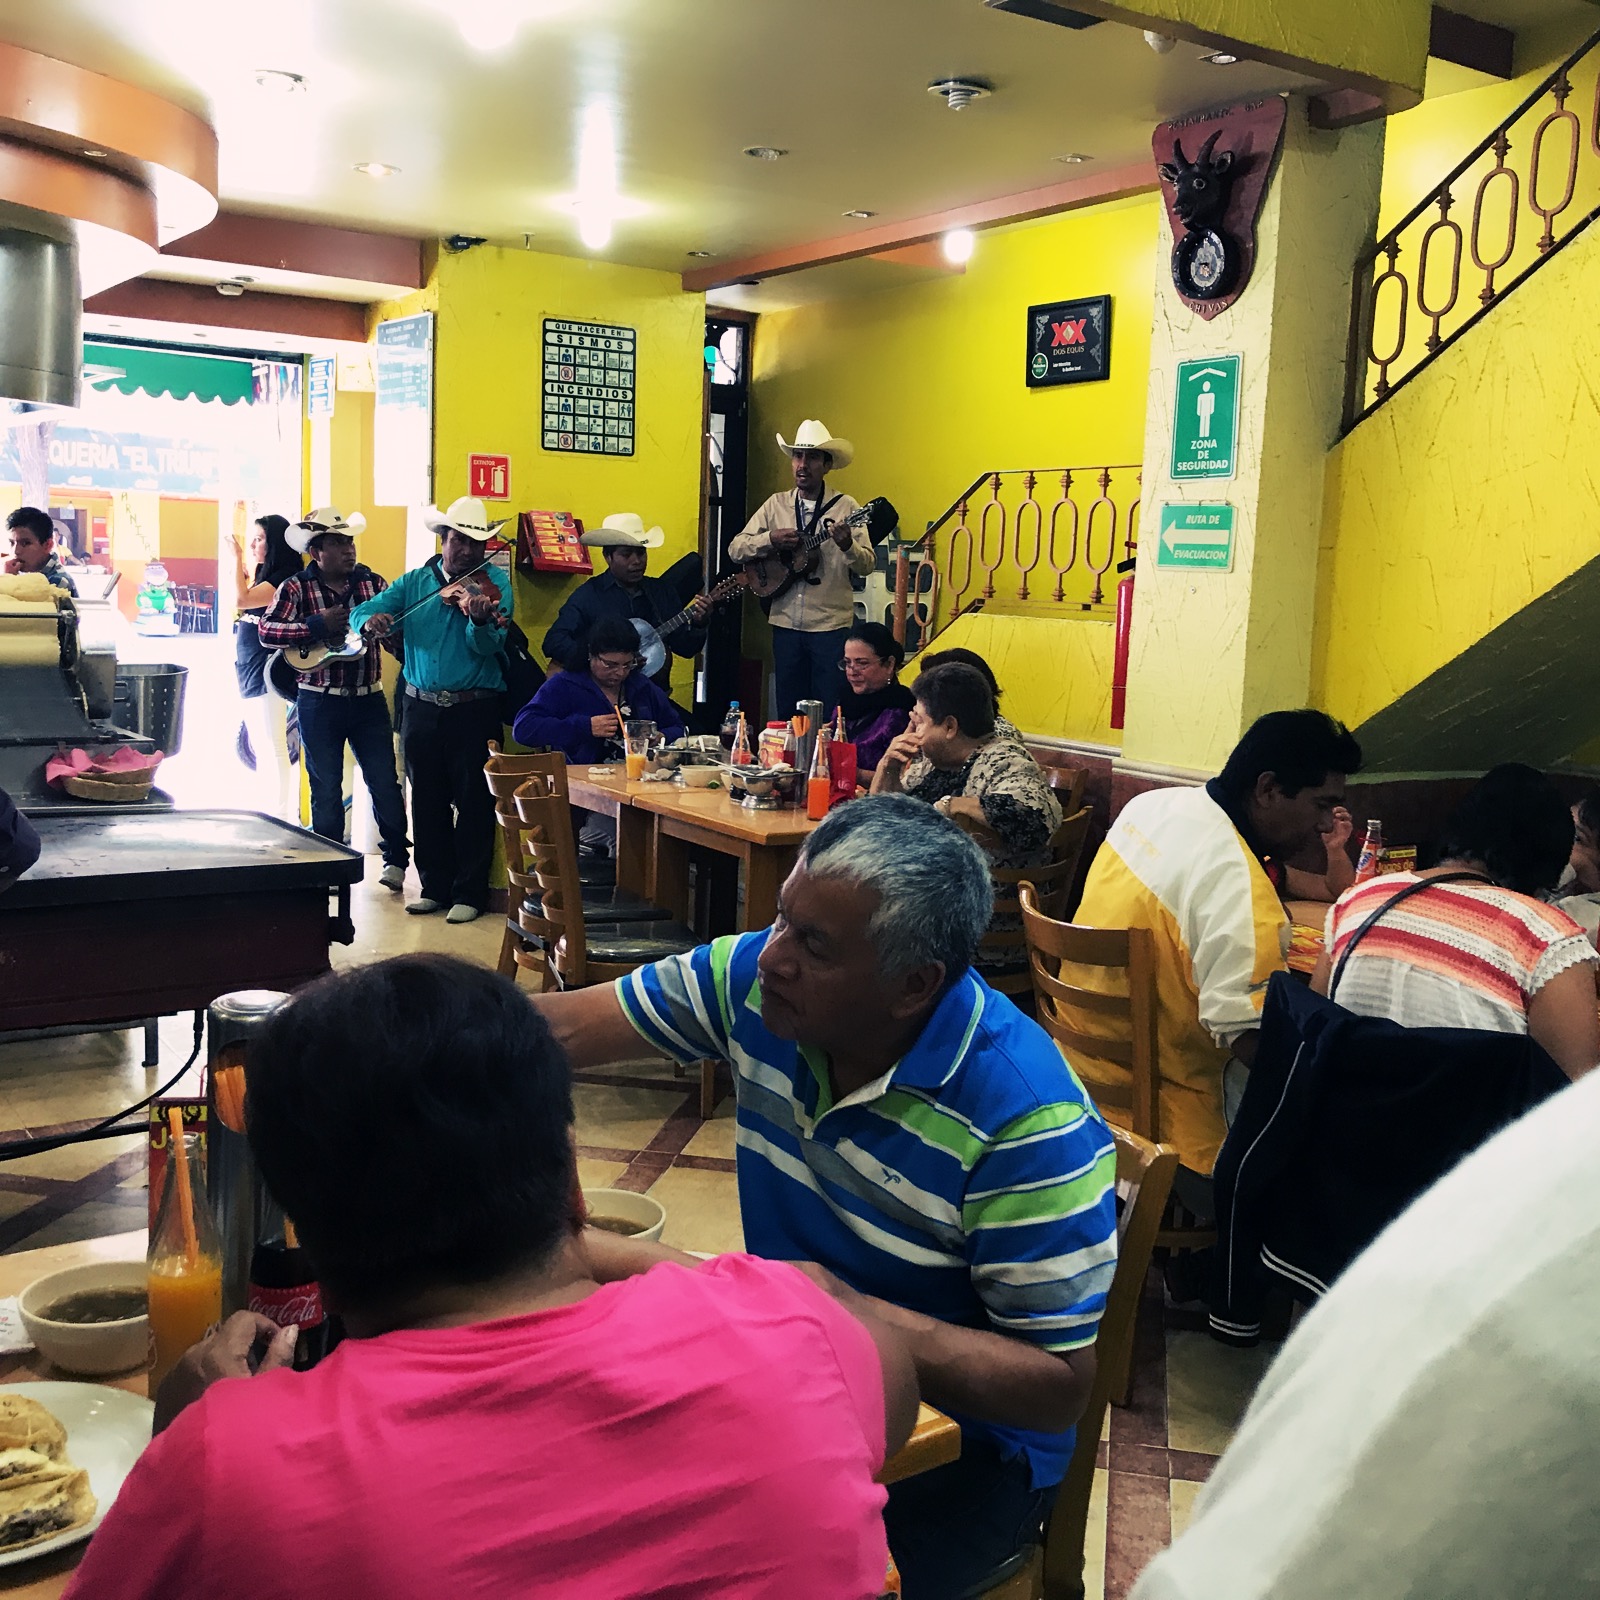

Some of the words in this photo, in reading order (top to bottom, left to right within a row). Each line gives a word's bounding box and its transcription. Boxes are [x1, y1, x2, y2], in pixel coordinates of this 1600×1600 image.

[1188, 300, 1228, 313] CHIVAS
[555, 322, 573, 331] QUE
[577, 325, 606, 334] HACER
[1050, 318, 1087, 347] XX
[556, 334, 623, 350] SISMOS
[1066, 345, 1085, 354] EQUIS
[550, 383, 628, 400] INCENDIOS
[1190, 439, 1218, 450] ZONA
[48, 439, 119, 471] QUERIA
[1197, 450, 1210, 459] DE
[473, 459, 496, 467] EXTINTOR
[1177, 459, 1229, 472] SEGURIDAD
[1185, 514, 1207, 525] RUTA
[1208, 514, 1220, 525] DE
[1173, 549, 1227, 560] EVACUACION
